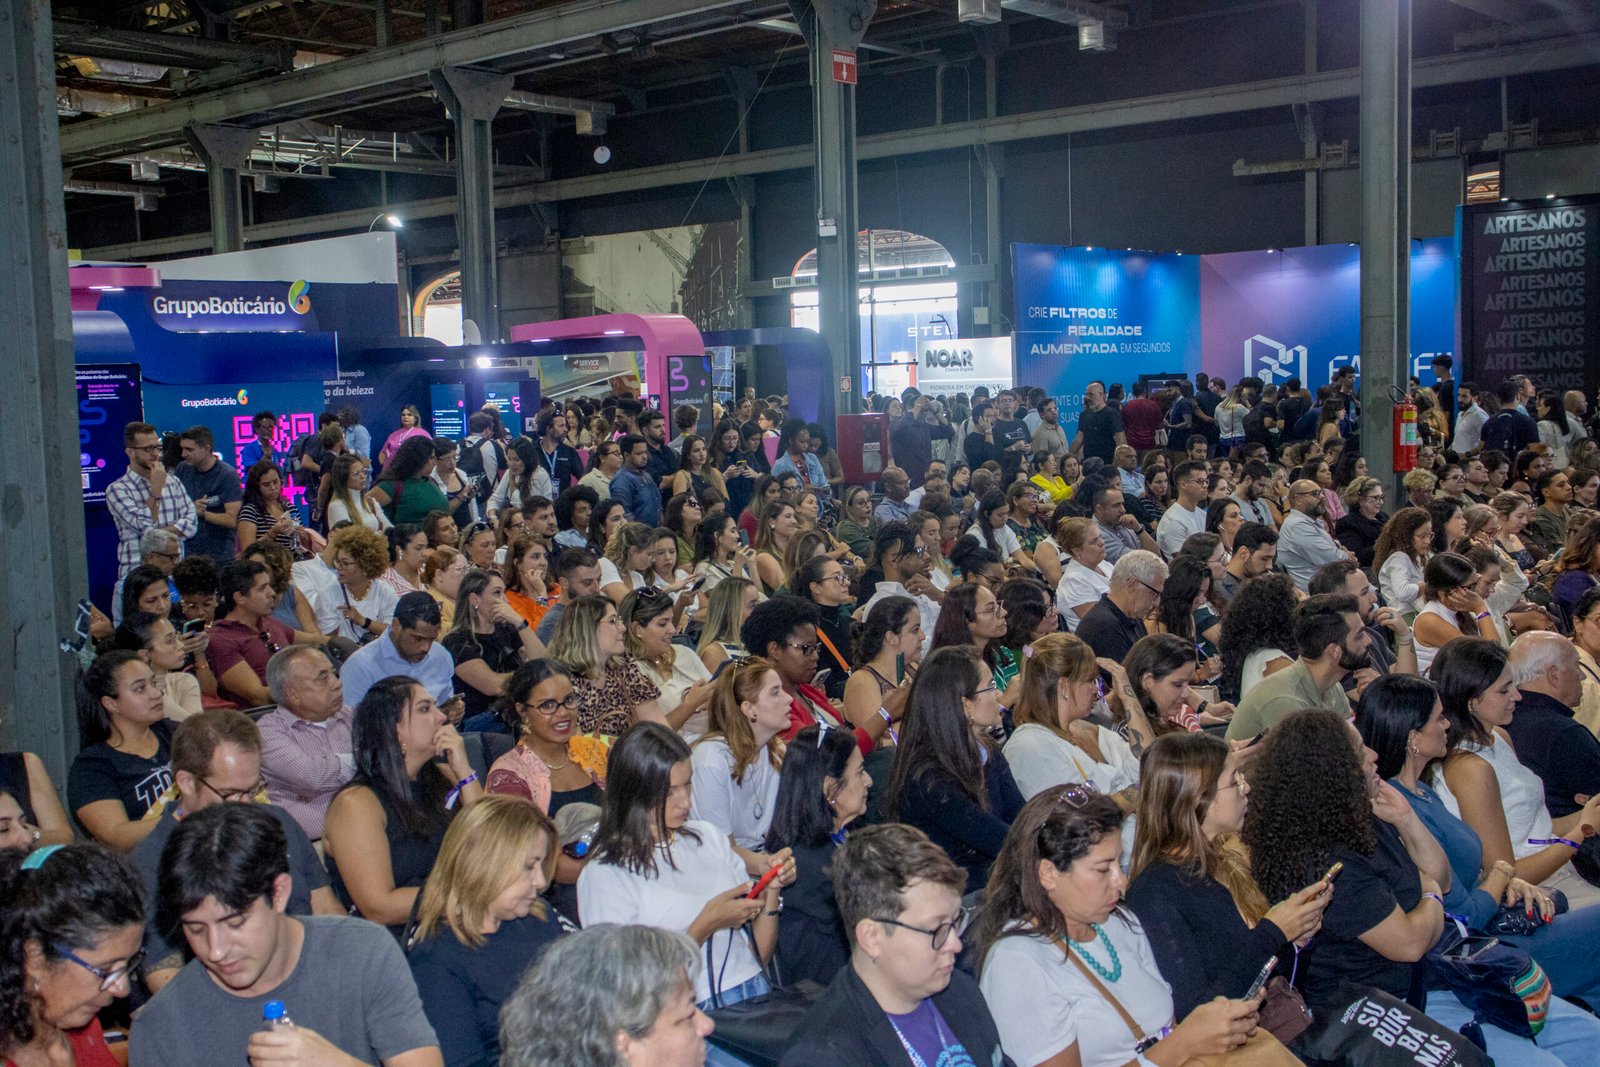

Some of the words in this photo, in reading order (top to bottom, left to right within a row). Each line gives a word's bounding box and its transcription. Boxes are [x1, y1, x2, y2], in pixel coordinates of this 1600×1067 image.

[1484, 210, 1586, 234] ARTESANOS
[1501, 233, 1586, 252] ARTESANOS
[1484, 250, 1586, 273] ARTESANOS
[1501, 272, 1586, 290] ARTESANOS
[153, 295, 286, 318] GrupoBoticário
[1484, 290, 1586, 311] ARTESANOS
[1028, 307, 1048, 318] CRIE
[1049, 308, 1106, 319] FILTROS
[1108, 308, 1118, 318] DE
[1501, 312, 1585, 329] ARTESANOS
[1068, 325, 1142, 336] REALIDADE
[1484, 330, 1584, 348] ARTESANOS
[1030, 343, 1118, 355] AUMENTADA
[1120, 342, 1132, 353] EM
[1132, 342, 1171, 353] SEGUNDOS
[926, 349, 973, 368] NOAR
[1484, 352, 1584, 370] ARTESANOS
[332, 387, 344, 396] da
[346, 386, 374, 396] beleza
[181, 397, 237, 410] GrupoBoticário
[1357, 1001, 1386, 1028] SU
[1372, 1007, 1412, 1047] BUR
[1396, 1026, 1429, 1053] BA
[1414, 1034, 1452, 1067] NAS
